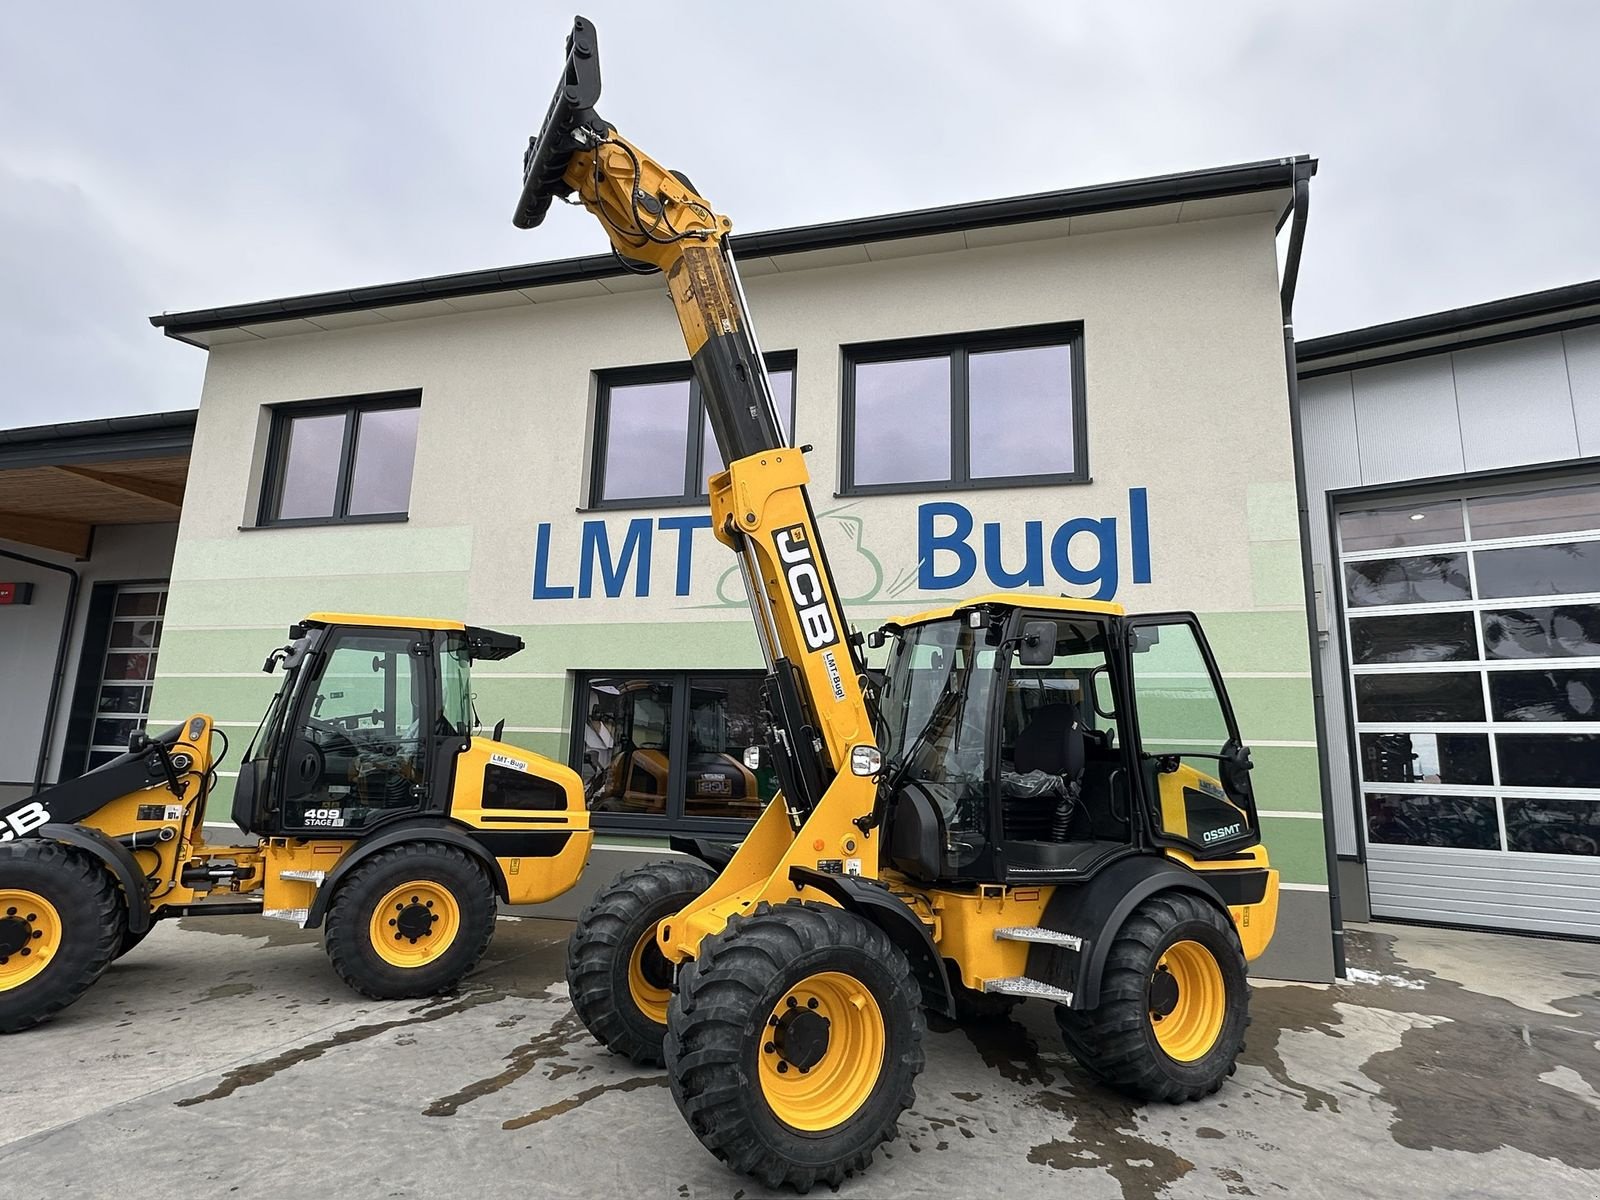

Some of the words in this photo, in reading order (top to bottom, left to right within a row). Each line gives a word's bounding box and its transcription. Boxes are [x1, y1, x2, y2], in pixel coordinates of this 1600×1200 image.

[532, 515, 713, 600] LMT
[917, 486, 1152, 602] Bugl
[776, 530, 836, 650] JCB
[826, 652, 845, 698] LMT-Bugl
[492, 753, 526, 769] LMT-Bugl
[304, 808, 340, 819] 409
[304, 818, 332, 826] STAGE
